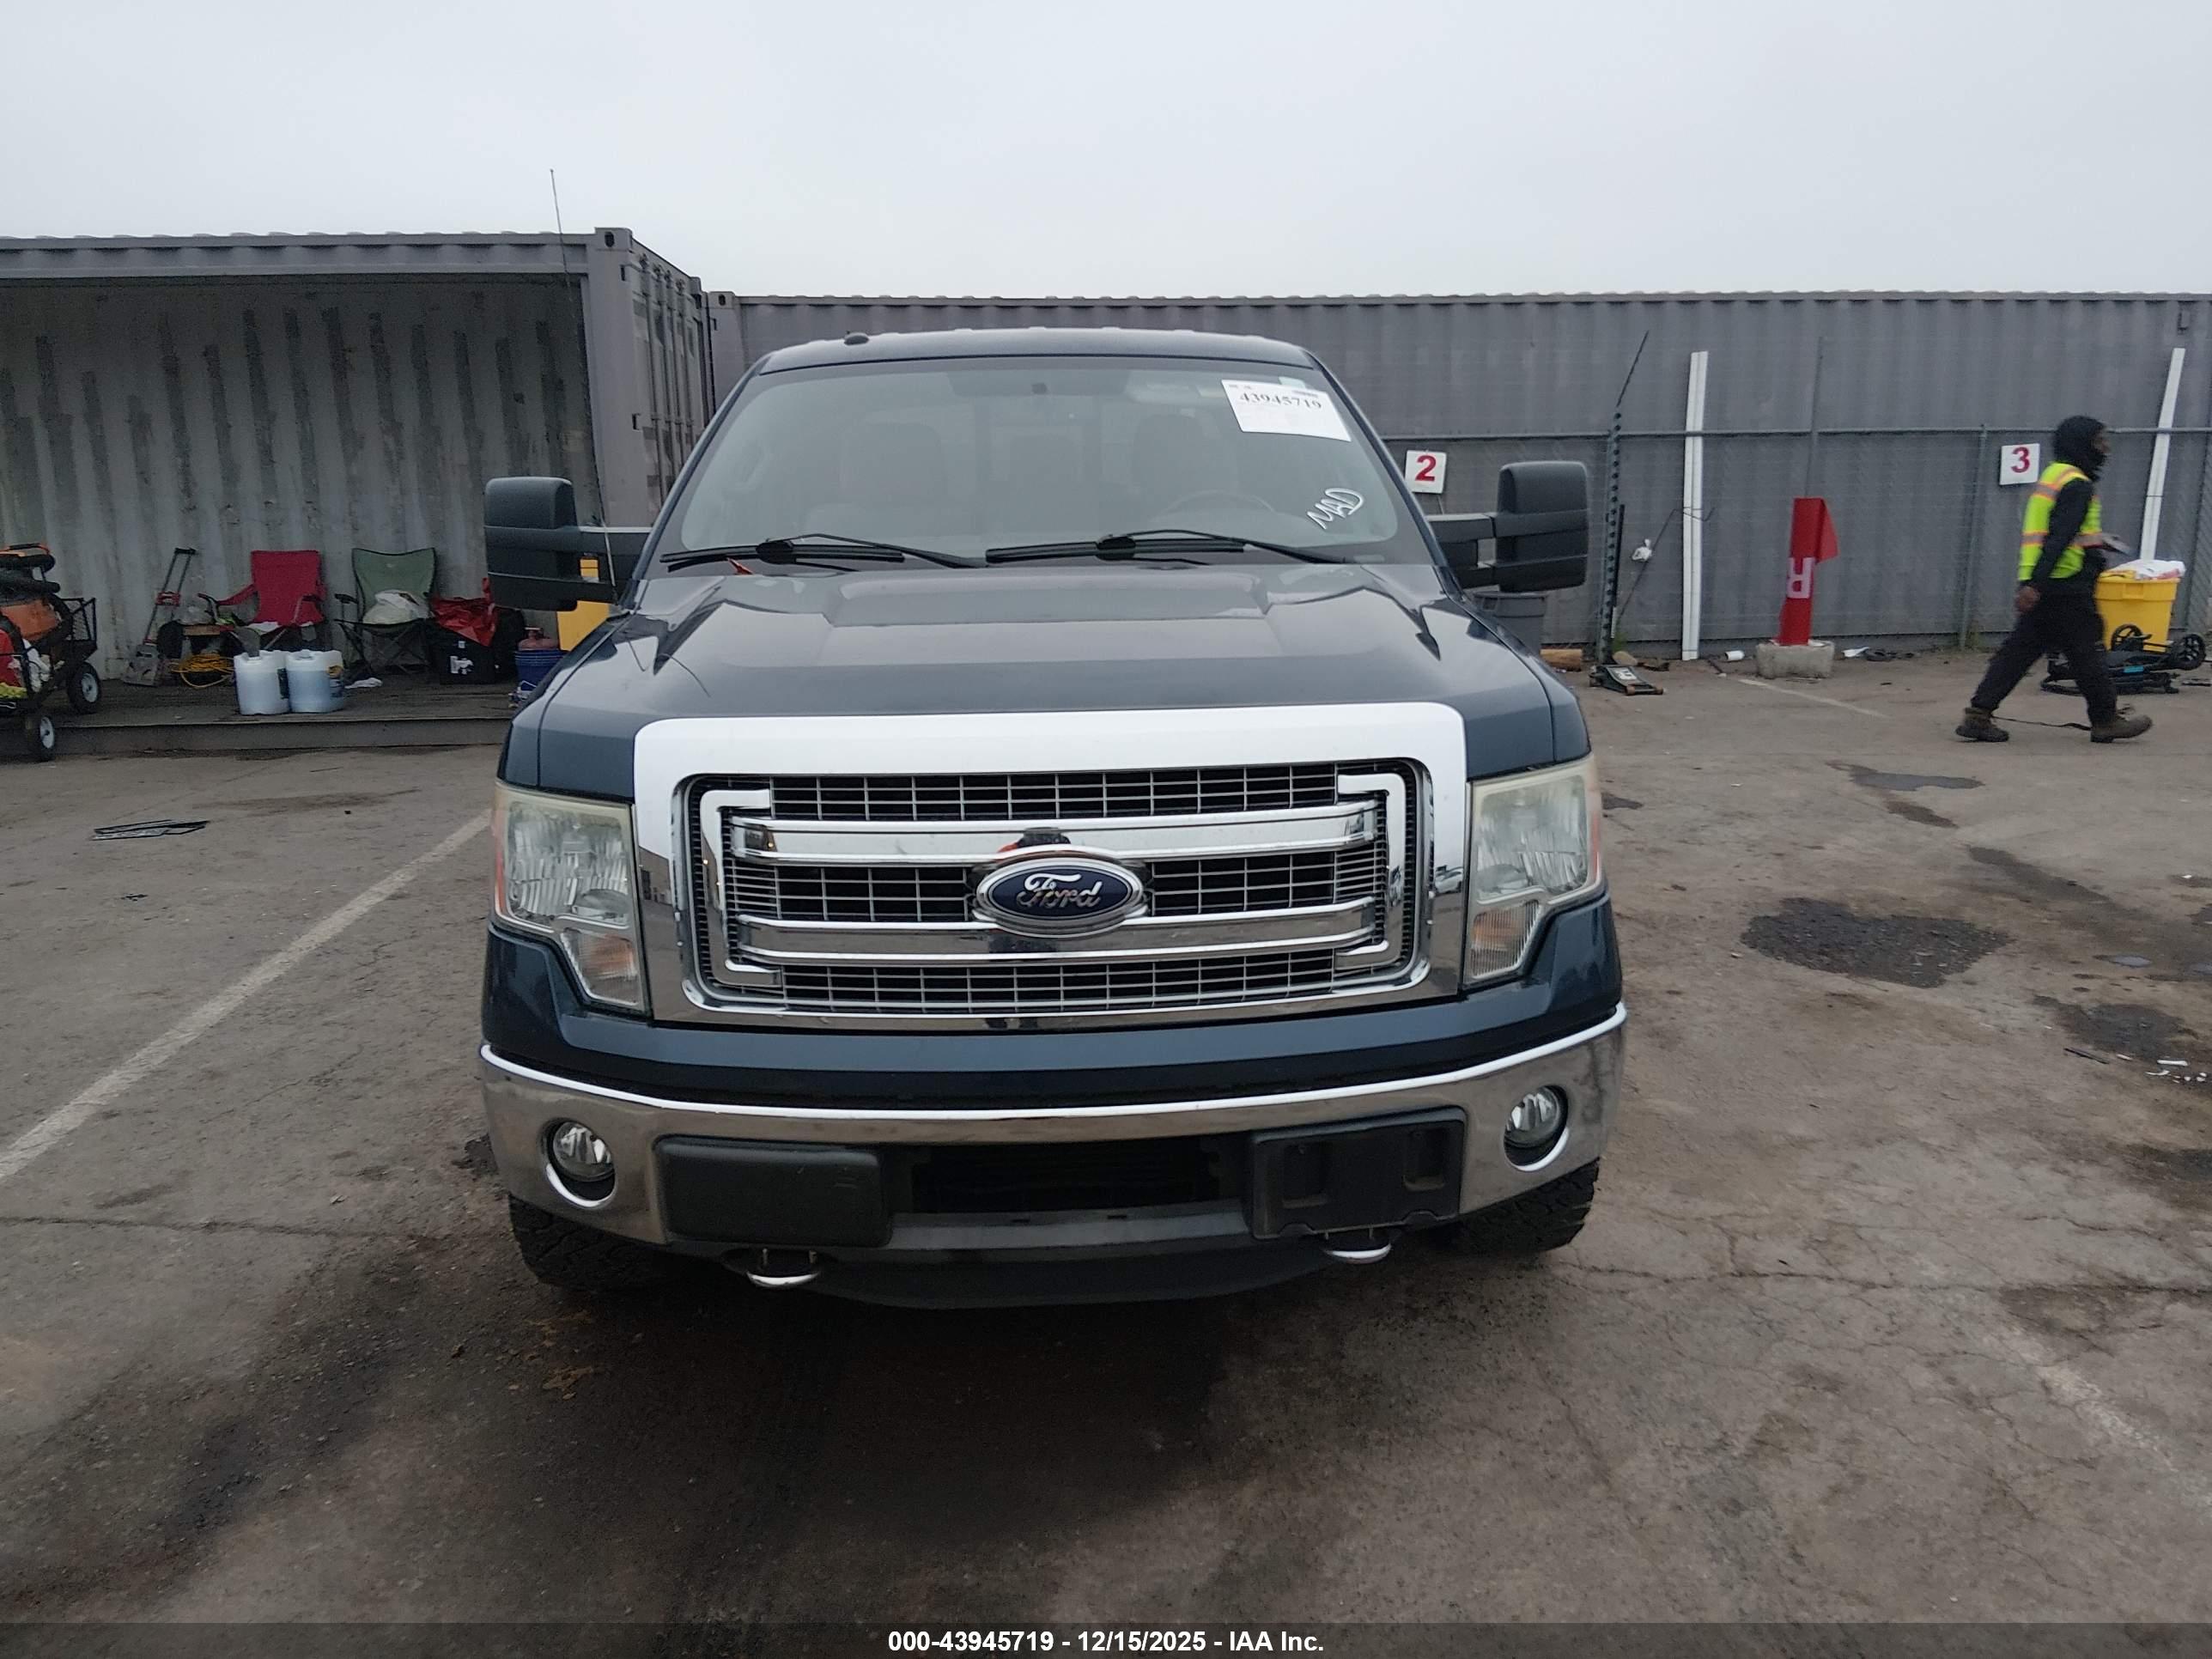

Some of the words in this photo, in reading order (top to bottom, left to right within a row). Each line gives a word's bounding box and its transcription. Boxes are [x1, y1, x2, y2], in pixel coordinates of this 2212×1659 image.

[1239, 392, 1322, 410] 43945719
[1414, 454, 1437, 482] 2
[2010, 446, 2031, 473] 3
[1017, 872, 1103, 908] Ford
